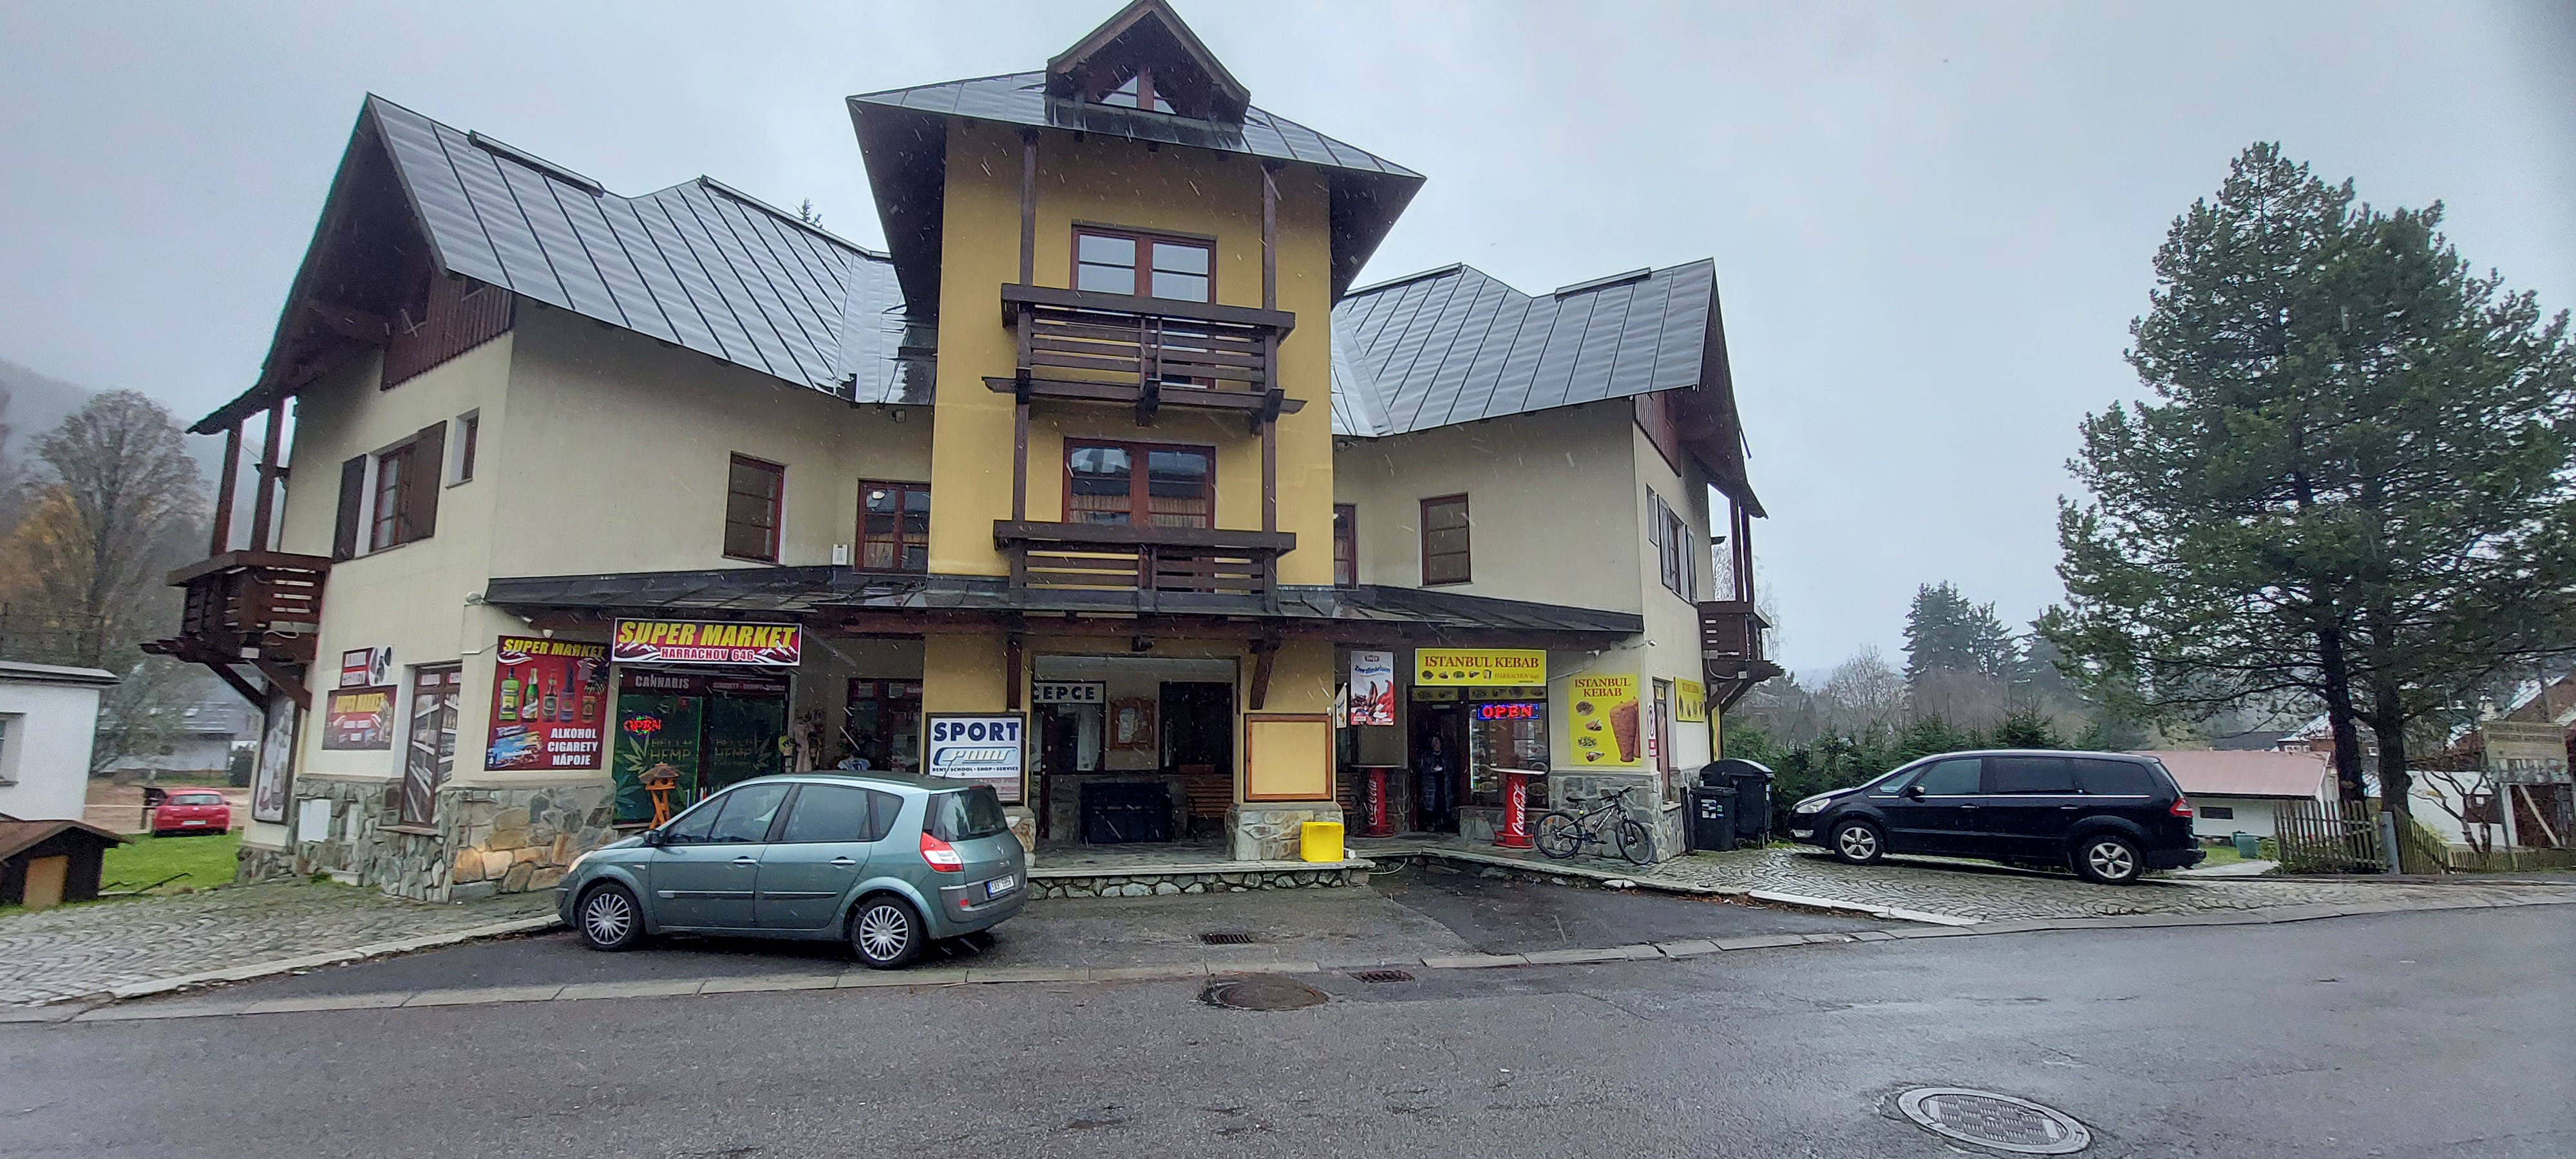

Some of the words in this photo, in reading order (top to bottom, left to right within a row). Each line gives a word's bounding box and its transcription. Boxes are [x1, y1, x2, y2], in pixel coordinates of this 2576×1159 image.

[618, 621, 696, 645] SUPER
[700, 624, 797, 648] MARKET
[503, 639, 549, 655] SUPER
[550, 643, 605, 657] MARKET
[661, 648, 728, 661] HARRACHOV
[732, 650, 754, 661] 646
[1425, 656, 1492, 668] ISTANBUL
[1495, 657, 1539, 668] KEBAB
[635, 676, 690, 690] CANNABIS
[1575, 678, 1631, 688] ISTANBUL
[1583, 688, 1622, 697] KEBAB
[1482, 706, 1533, 717] OPEN
[623, 719, 662, 732] OPEN
[934, 722, 1019, 741] SPORT
[550, 728, 596, 739] ALKOHOL
[547, 741, 598, 752] CIGARETY
[552, 753, 591, 766] NÁPOJE
[650, 749, 692, 760] HEMP
